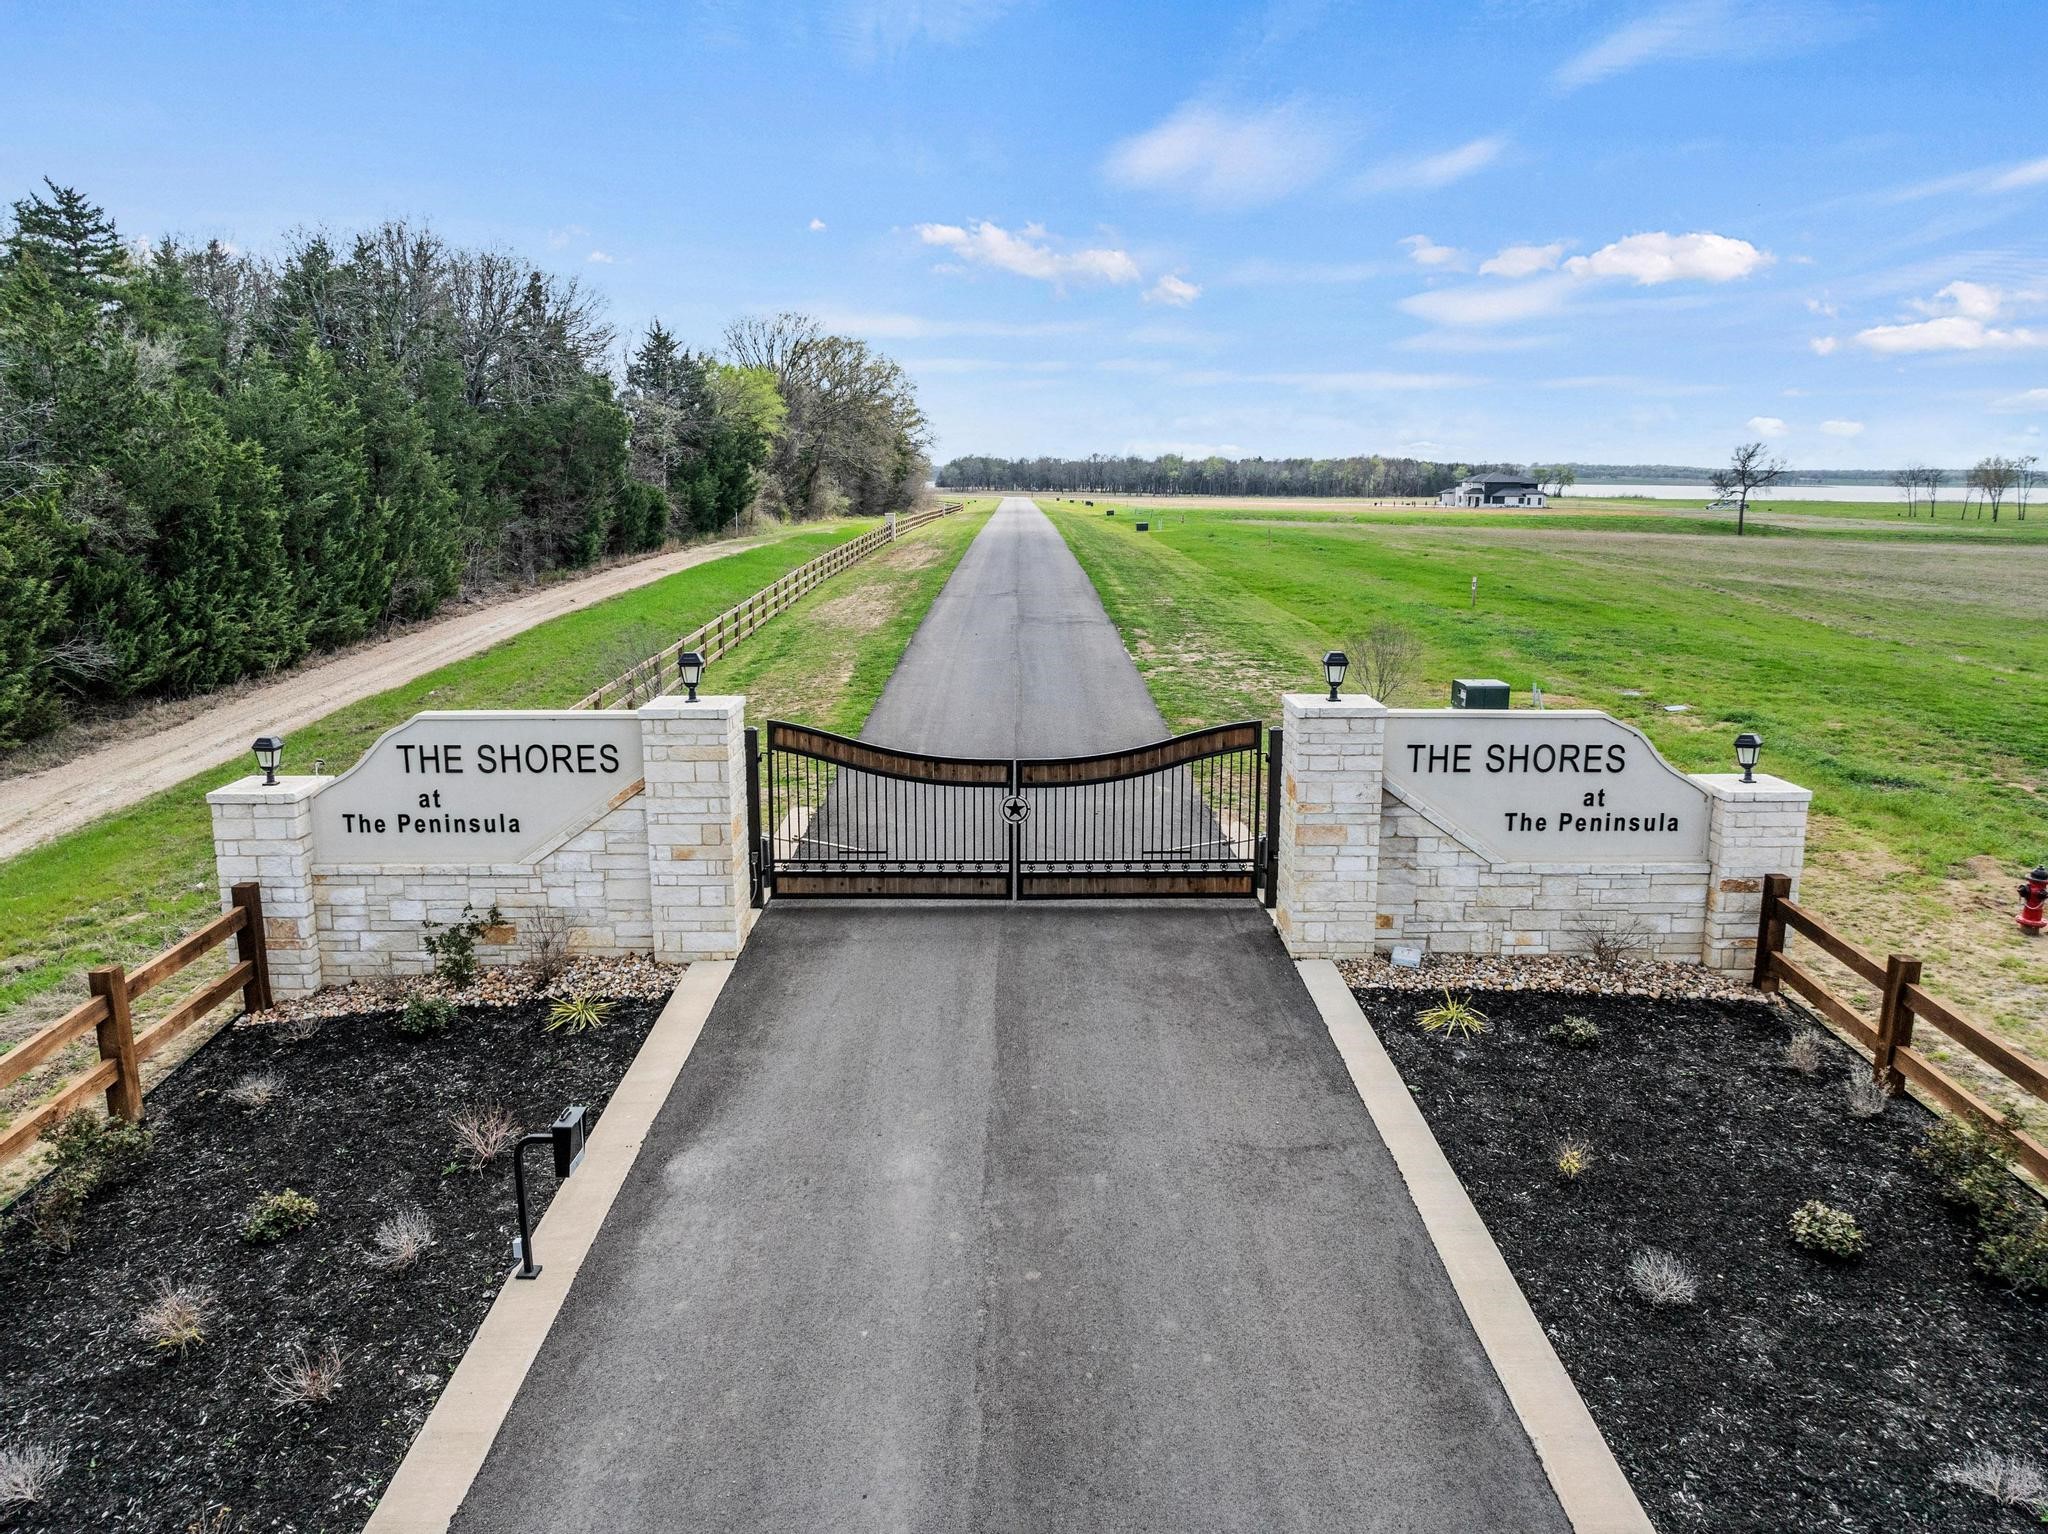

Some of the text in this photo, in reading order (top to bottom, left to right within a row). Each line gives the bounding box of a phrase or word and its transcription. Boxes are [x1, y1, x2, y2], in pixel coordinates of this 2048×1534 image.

[396, 743, 620, 774] THE SHORES
[1407, 743, 1626, 774] THE SHORES
[418, 788, 442, 809] at
[1583, 788, 1606, 808] at
[342, 813, 521, 834] The Peninsula
[1505, 812, 1679, 832] The Peninsula
